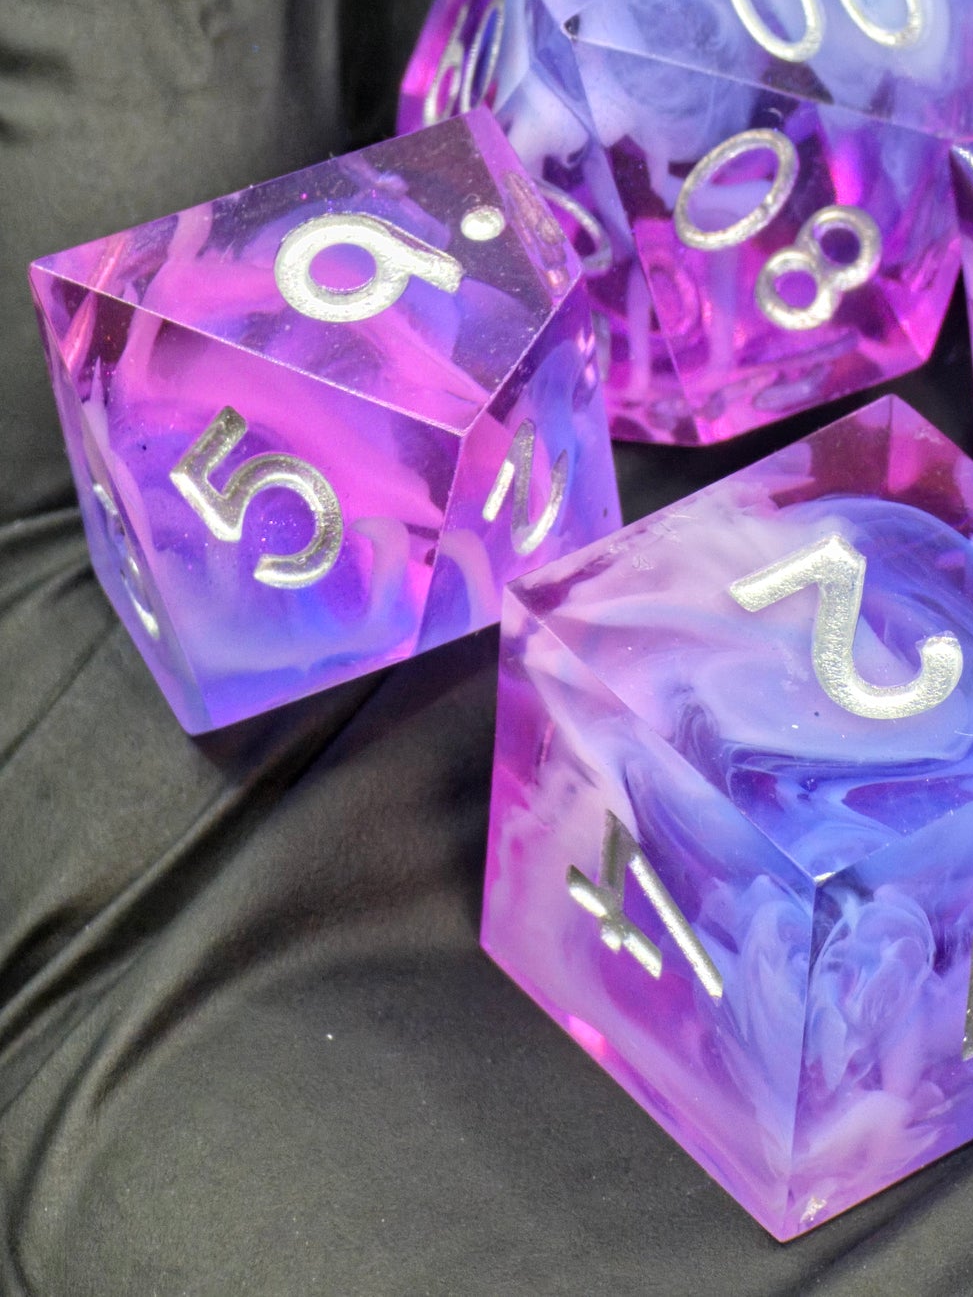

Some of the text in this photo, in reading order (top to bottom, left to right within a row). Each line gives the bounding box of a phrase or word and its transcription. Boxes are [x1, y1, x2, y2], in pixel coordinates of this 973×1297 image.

[674, 129, 883, 330] 80
[169, 405, 344, 589] 5
[729, 533, 964, 720] 2
[565, 809, 723, 1000] 4
